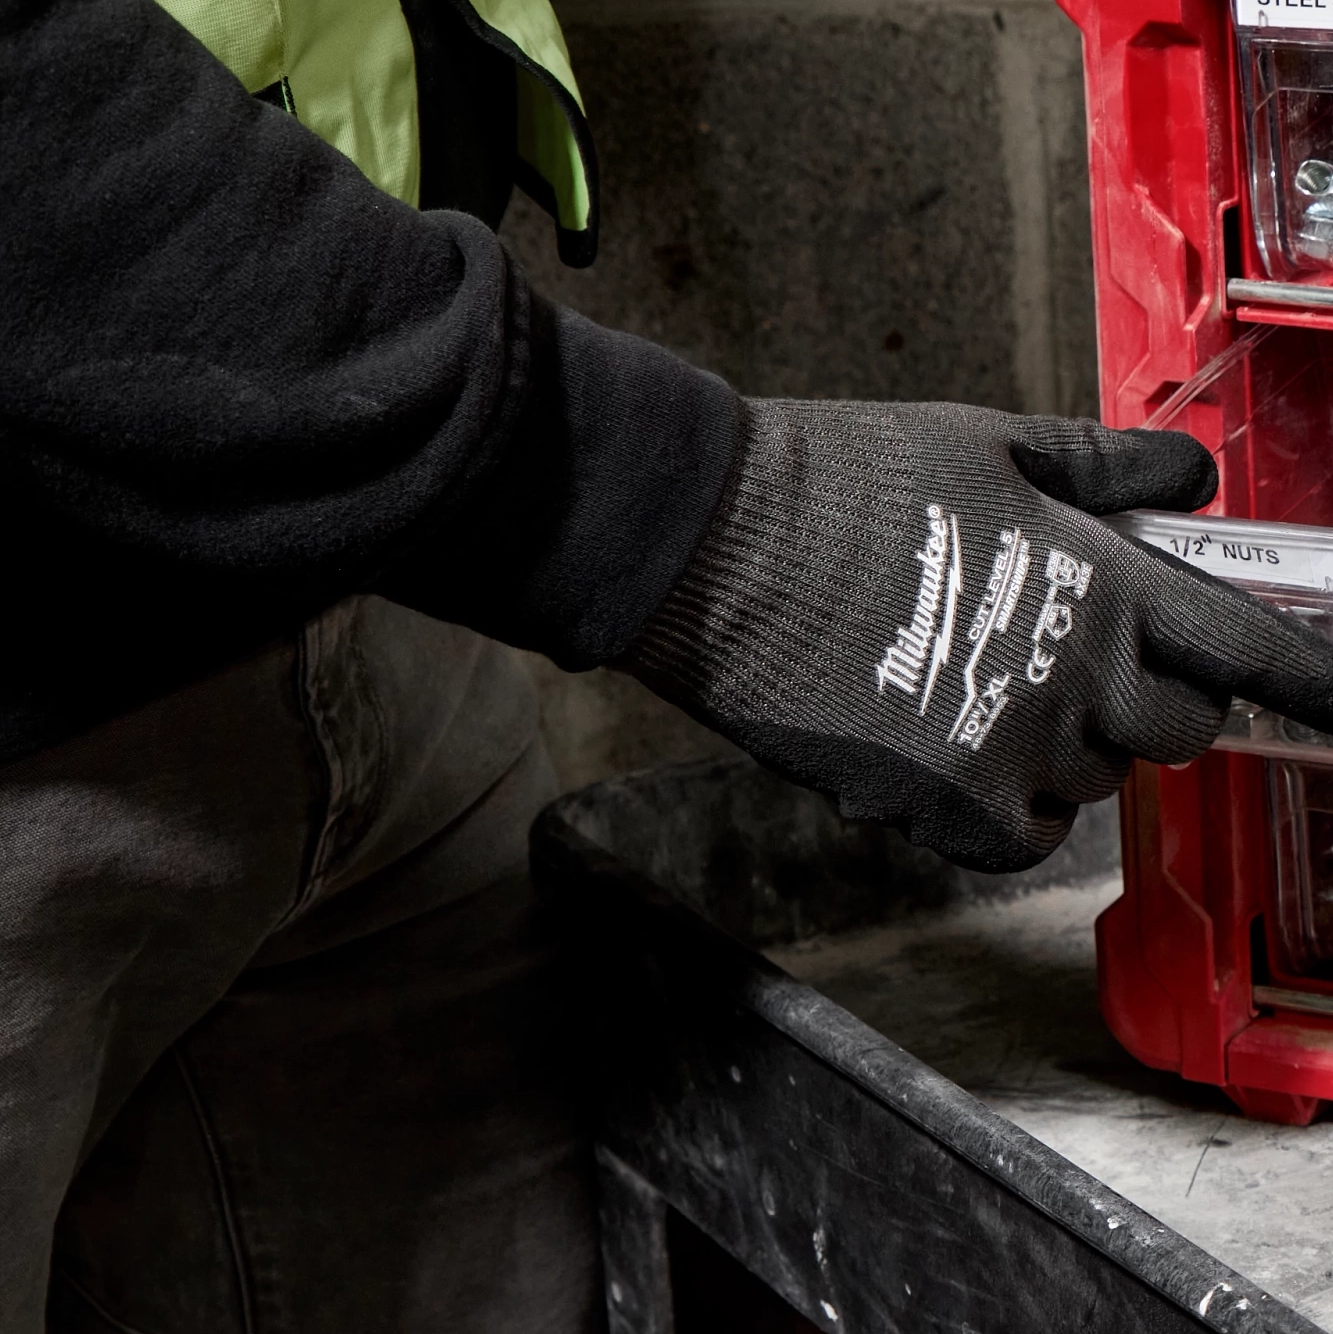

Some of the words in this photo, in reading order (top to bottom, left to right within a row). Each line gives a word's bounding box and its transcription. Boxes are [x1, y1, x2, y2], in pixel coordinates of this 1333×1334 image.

[1169, 533, 1212, 558] 1/2"
[1221, 543, 1280, 565] NUTS
[968, 605, 990, 640] CUT
[984, 551, 1009, 603] LEVEL
[1001, 531, 1013, 545] 5
[983, 674, 1011, 701] XL
